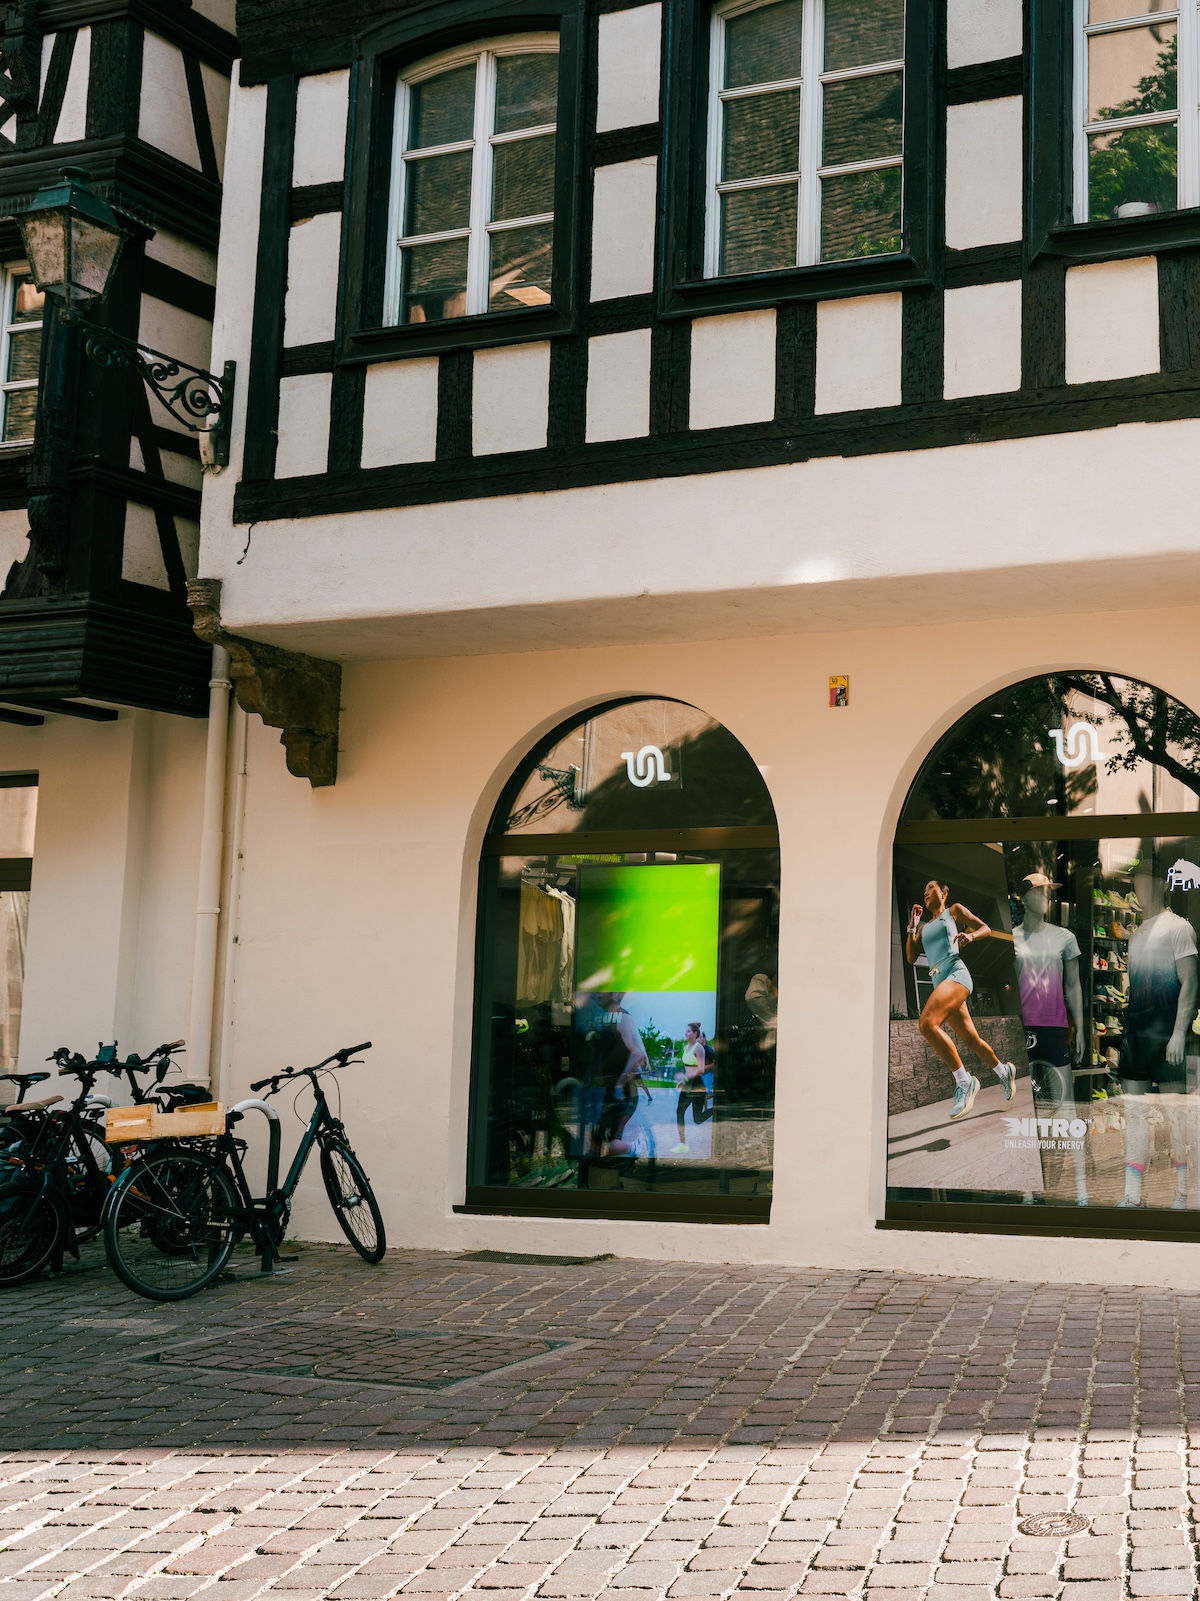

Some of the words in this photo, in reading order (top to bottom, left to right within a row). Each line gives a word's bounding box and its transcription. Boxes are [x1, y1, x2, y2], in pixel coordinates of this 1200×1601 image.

[1000, 1117, 1087, 1138] NITRO
[1005, 1140, 1036, 1148] UNLEASH
[1037, 1141, 1056, 1149] YOUR
[1058, 1141, 1085, 1149] ENERGY
